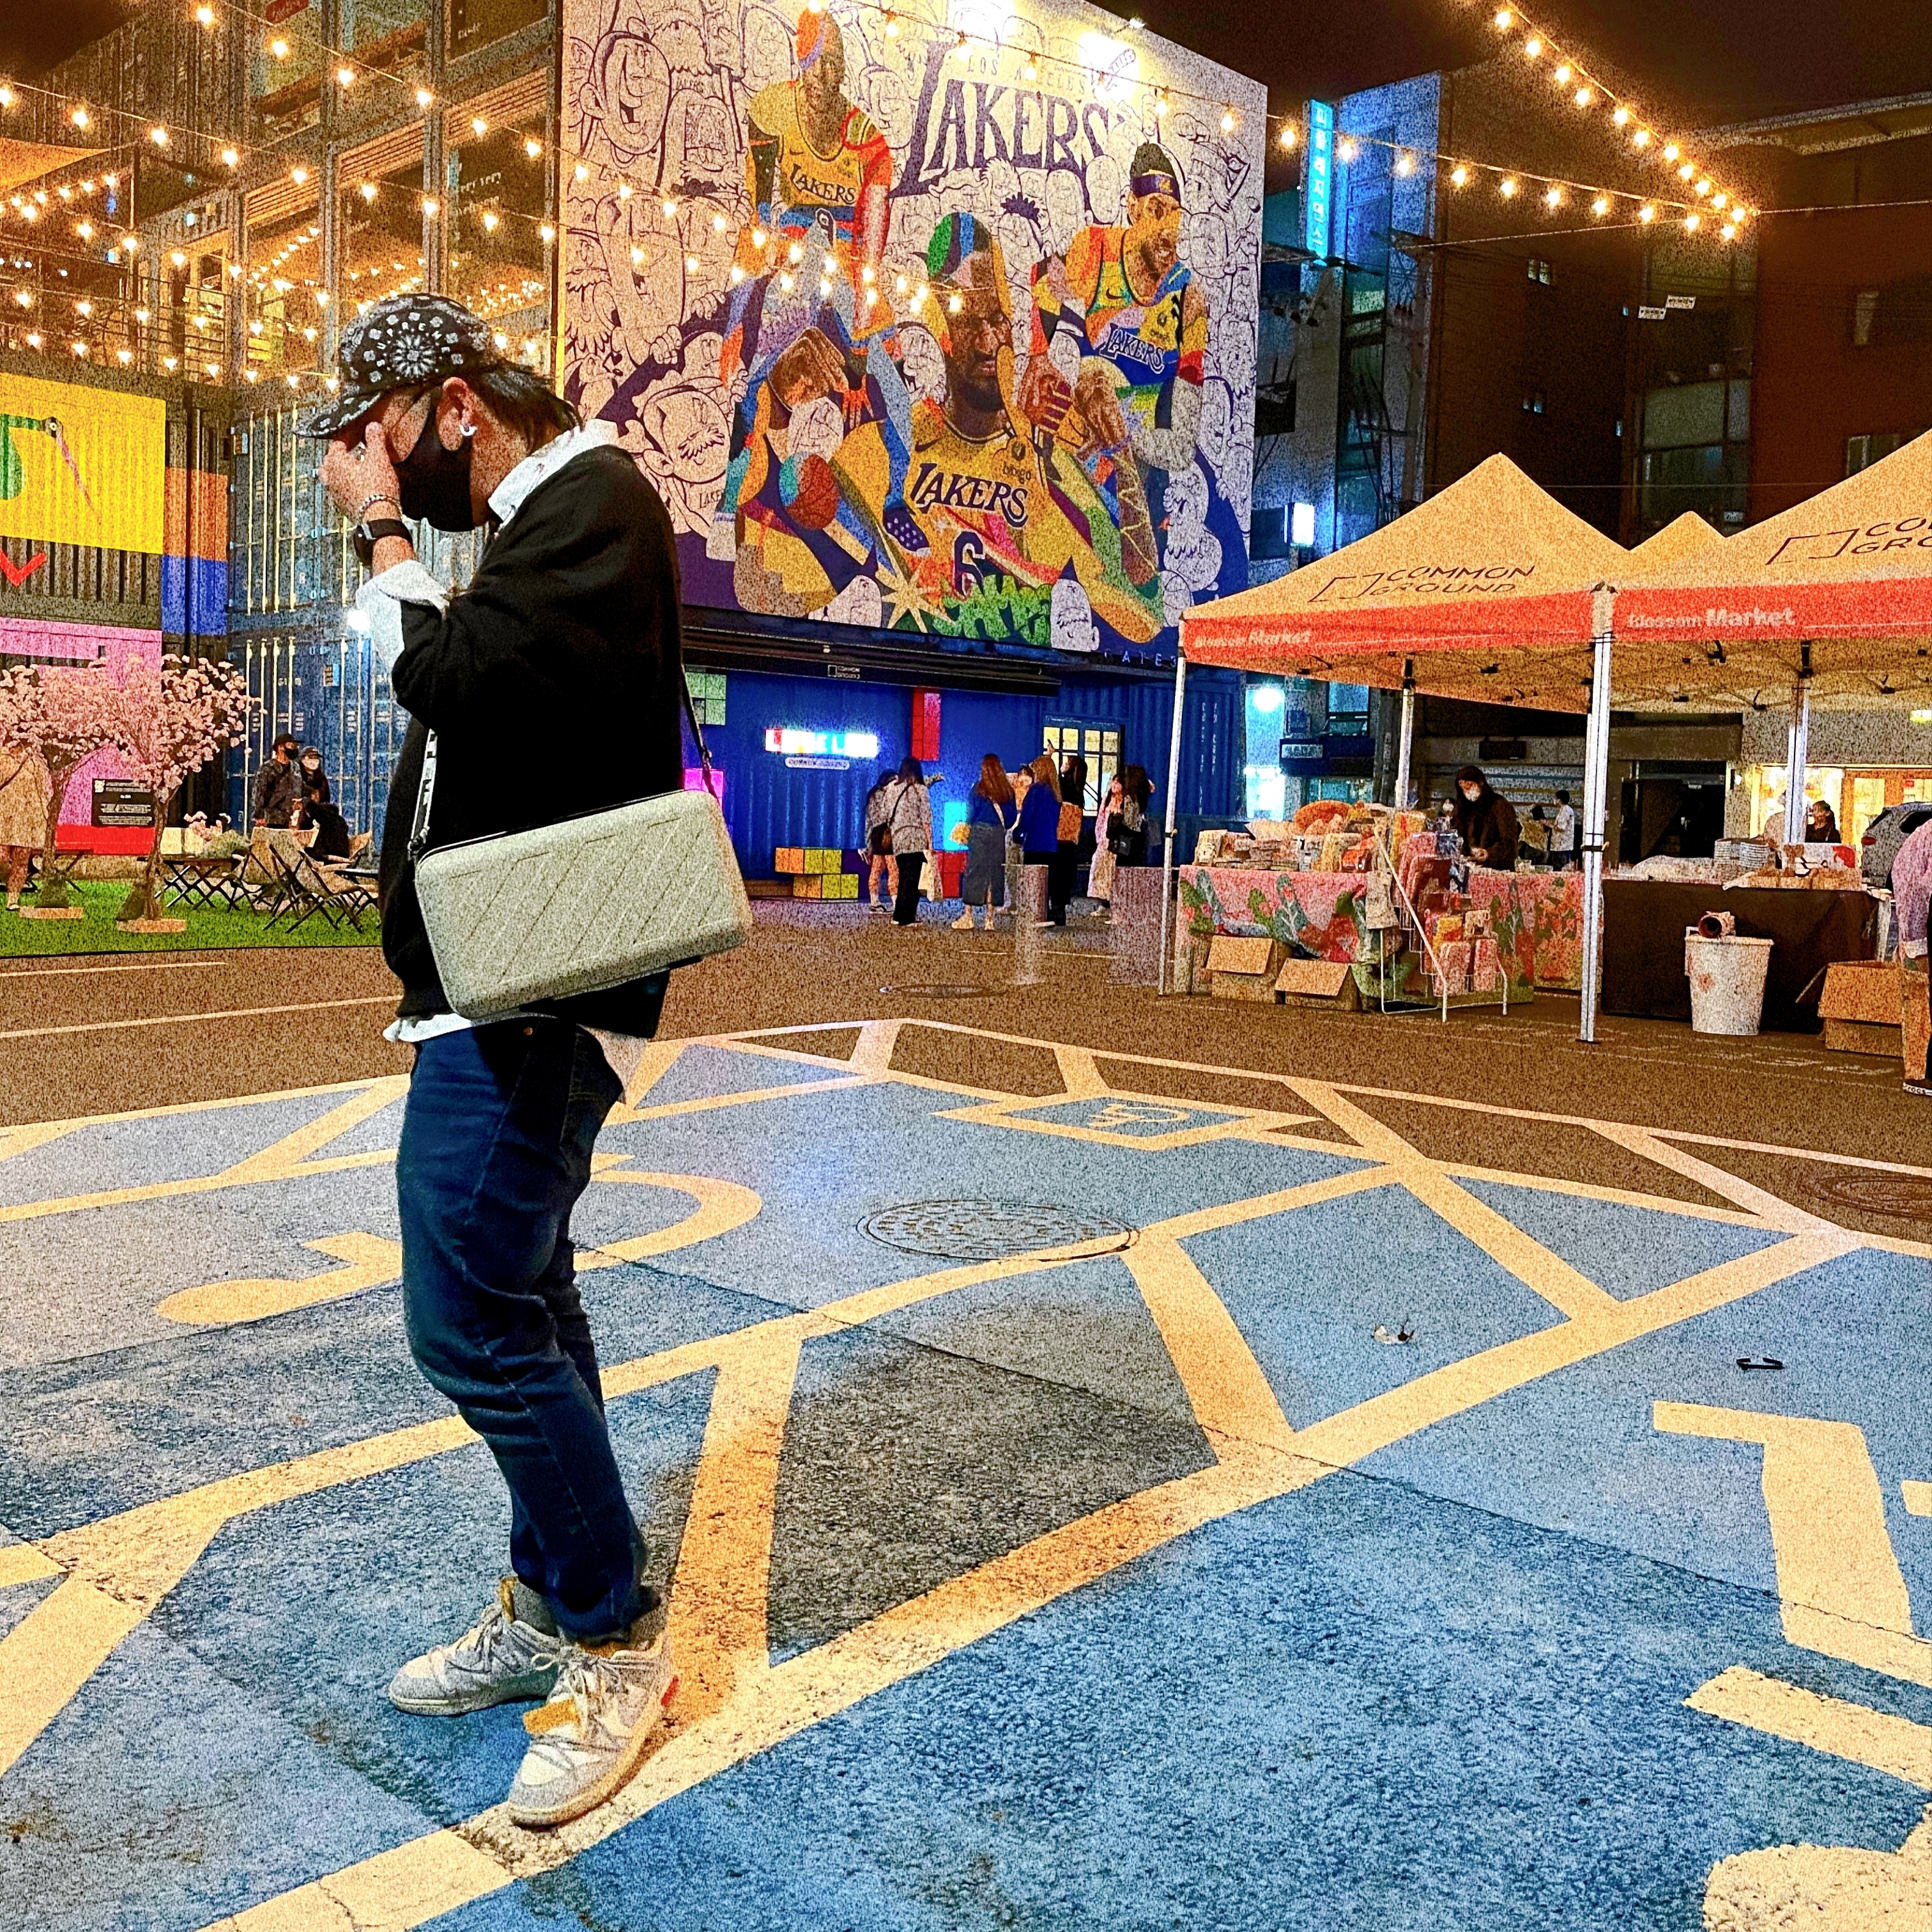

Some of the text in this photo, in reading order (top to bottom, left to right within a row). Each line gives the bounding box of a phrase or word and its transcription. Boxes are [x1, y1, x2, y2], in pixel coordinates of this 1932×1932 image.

[889, 40, 1110, 199] LAKERS
[790, 164, 856, 204] LAKERS
[1099, 323, 1165, 374] LAKERS
[910, 463, 1029, 528] LAKERS
[1369, 581, 1519, 596] GROUND
[1386, 565, 1535, 582] COMMON
[1705, 606, 1796, 629] Market
